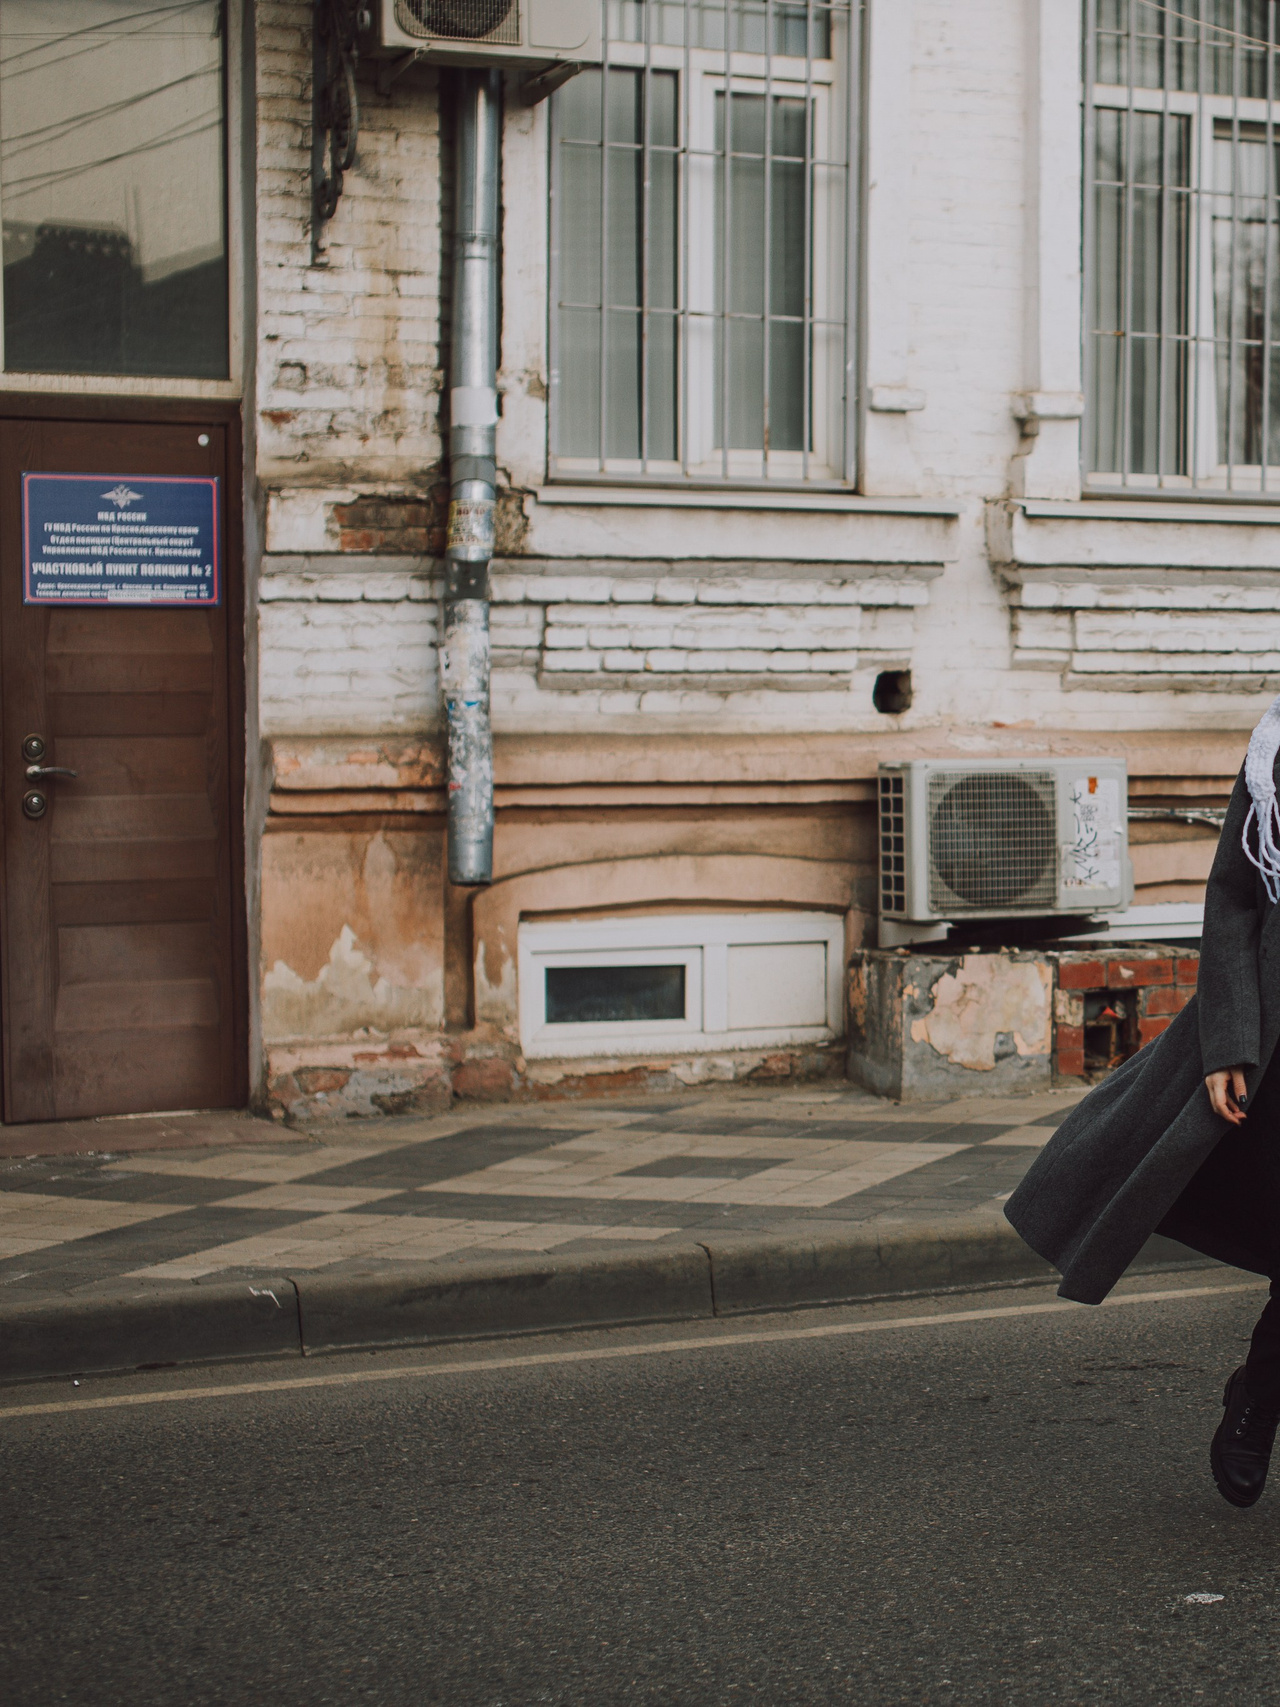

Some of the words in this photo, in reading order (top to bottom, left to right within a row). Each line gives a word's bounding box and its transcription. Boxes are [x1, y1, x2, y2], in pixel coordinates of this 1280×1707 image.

[97, 511, 115, 522] МВД
[117, 511, 147, 522] РОССИИ
[44, 522, 53, 532] ГУ
[53, 522, 71, 534] МВД
[72, 523, 100, 533] России
[101, 525, 110, 533] по
[111, 524, 178, 535] Краснодарскому
[178, 526, 199, 535] краю
[50, 534, 76, 545] Отдел
[76, 536, 110, 546] полиции
[111, 535, 169, 547] (Центральный
[42, 545, 90, 555] Управления
[90, 545, 108, 556] МВД
[109, 545, 137, 556] России
[138, 548, 147, 556] по
[154, 546, 201, 557] Краснодару
[32, 560, 103, 576] УЧАСТКОВЫЙ
[106, 563, 138, 576] ПУНКТ
[140, 564, 189, 578] ПОЛИЦИИ
[191, 564, 202, 576] №
[204, 564, 212, 577] 2
